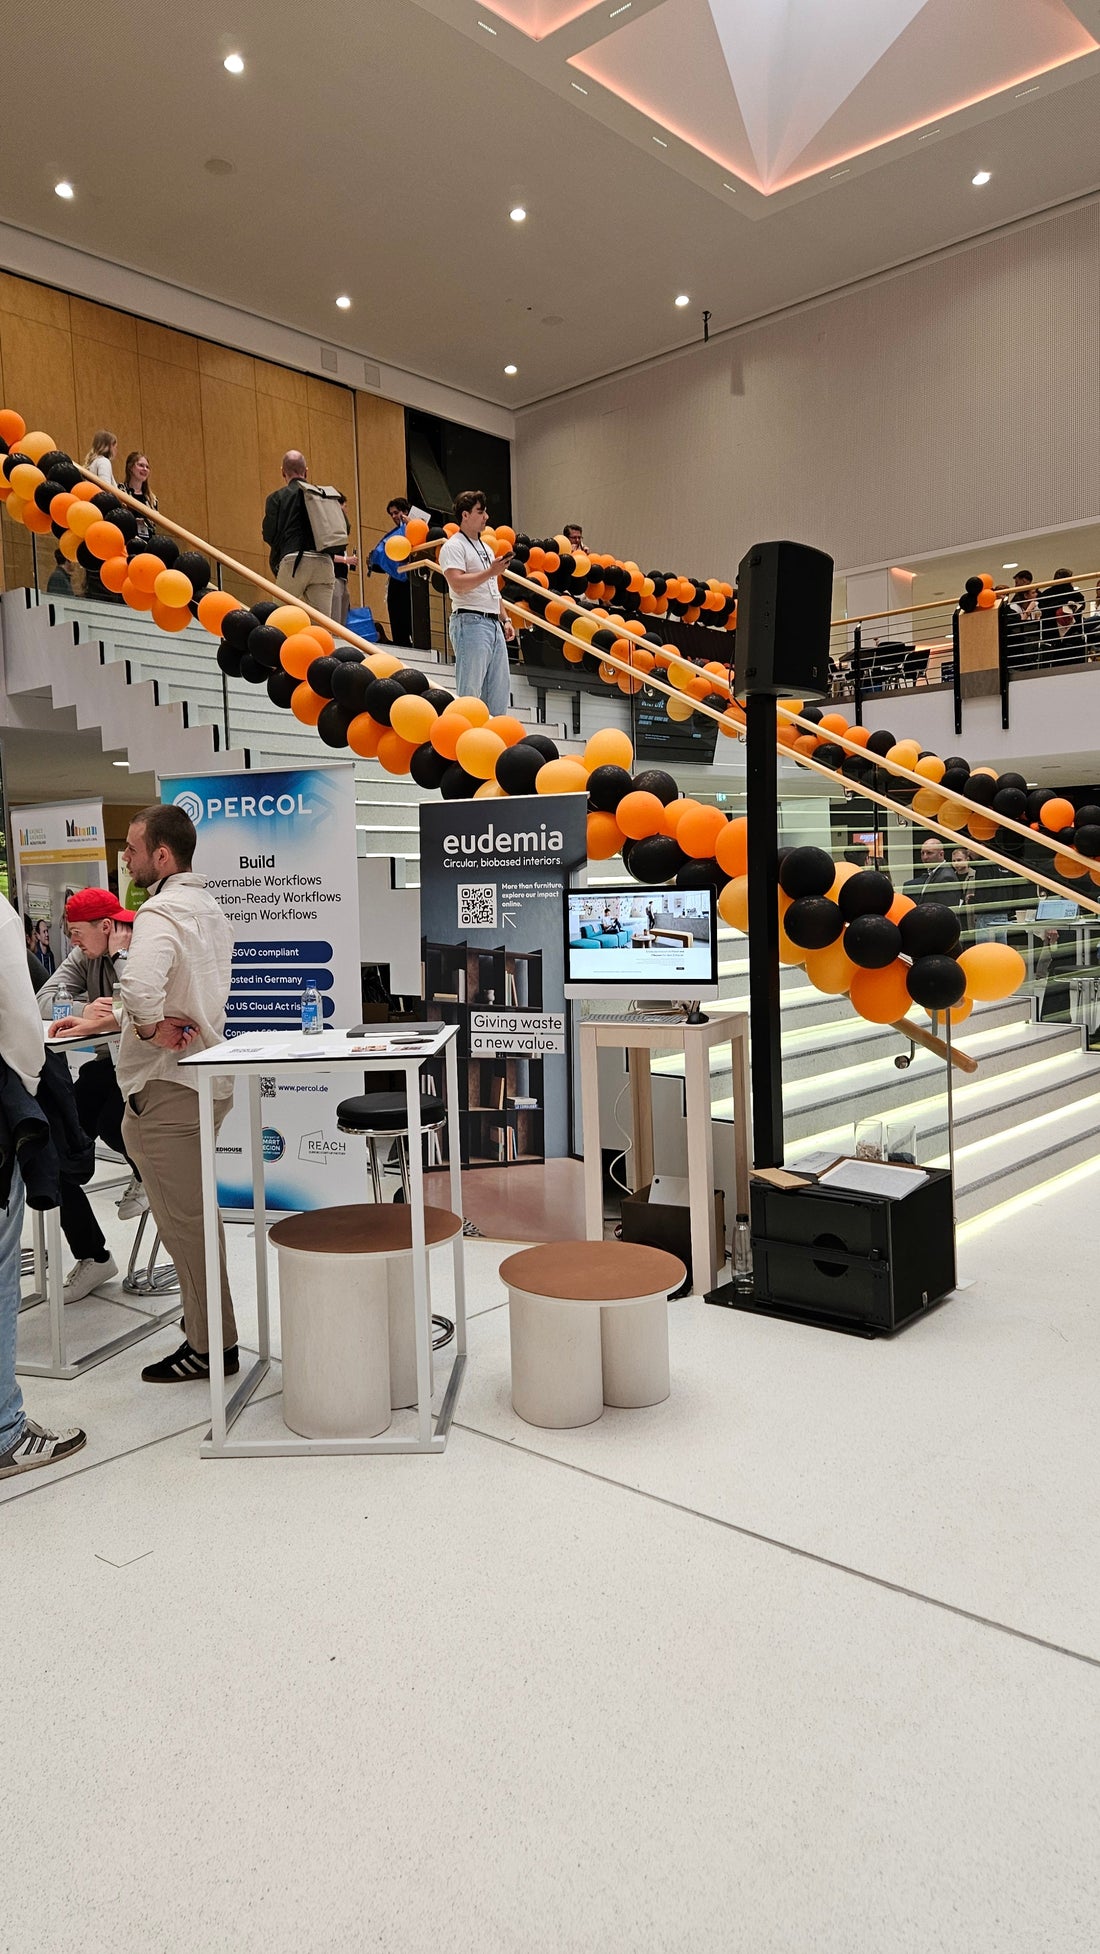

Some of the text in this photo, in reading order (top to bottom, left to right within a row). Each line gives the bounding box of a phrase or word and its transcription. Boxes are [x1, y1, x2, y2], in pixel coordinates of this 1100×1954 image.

[207, 794, 313, 819] PERCOL
[443, 823, 563, 854] eudemia
[239, 855, 275, 869] Build
[443, 856, 563, 869] Circular, biobased interiors.
[264, 874, 322, 887] Workflows
[534, 881, 564, 889] furniture,
[214, 891, 342, 906] ction-Ready Workflows
[536, 891, 559, 899] impact
[224, 908, 318, 923] ereign Workflows
[231, 947, 300, 958] SGVO compliant
[230, 975, 303, 985] osted in Germany
[235, 1002, 248, 1011] US
[249, 1002, 274, 1011] Cloud
[274, 1002, 290, 1011] Act
[290, 1002, 302, 1011] ris
[474, 1014, 562, 1031] Giving waste
[474, 1036, 558, 1050] a new value.
[278, 1084, 329, 1093] www.percol.de
[308, 1141, 346, 1151] REACH
